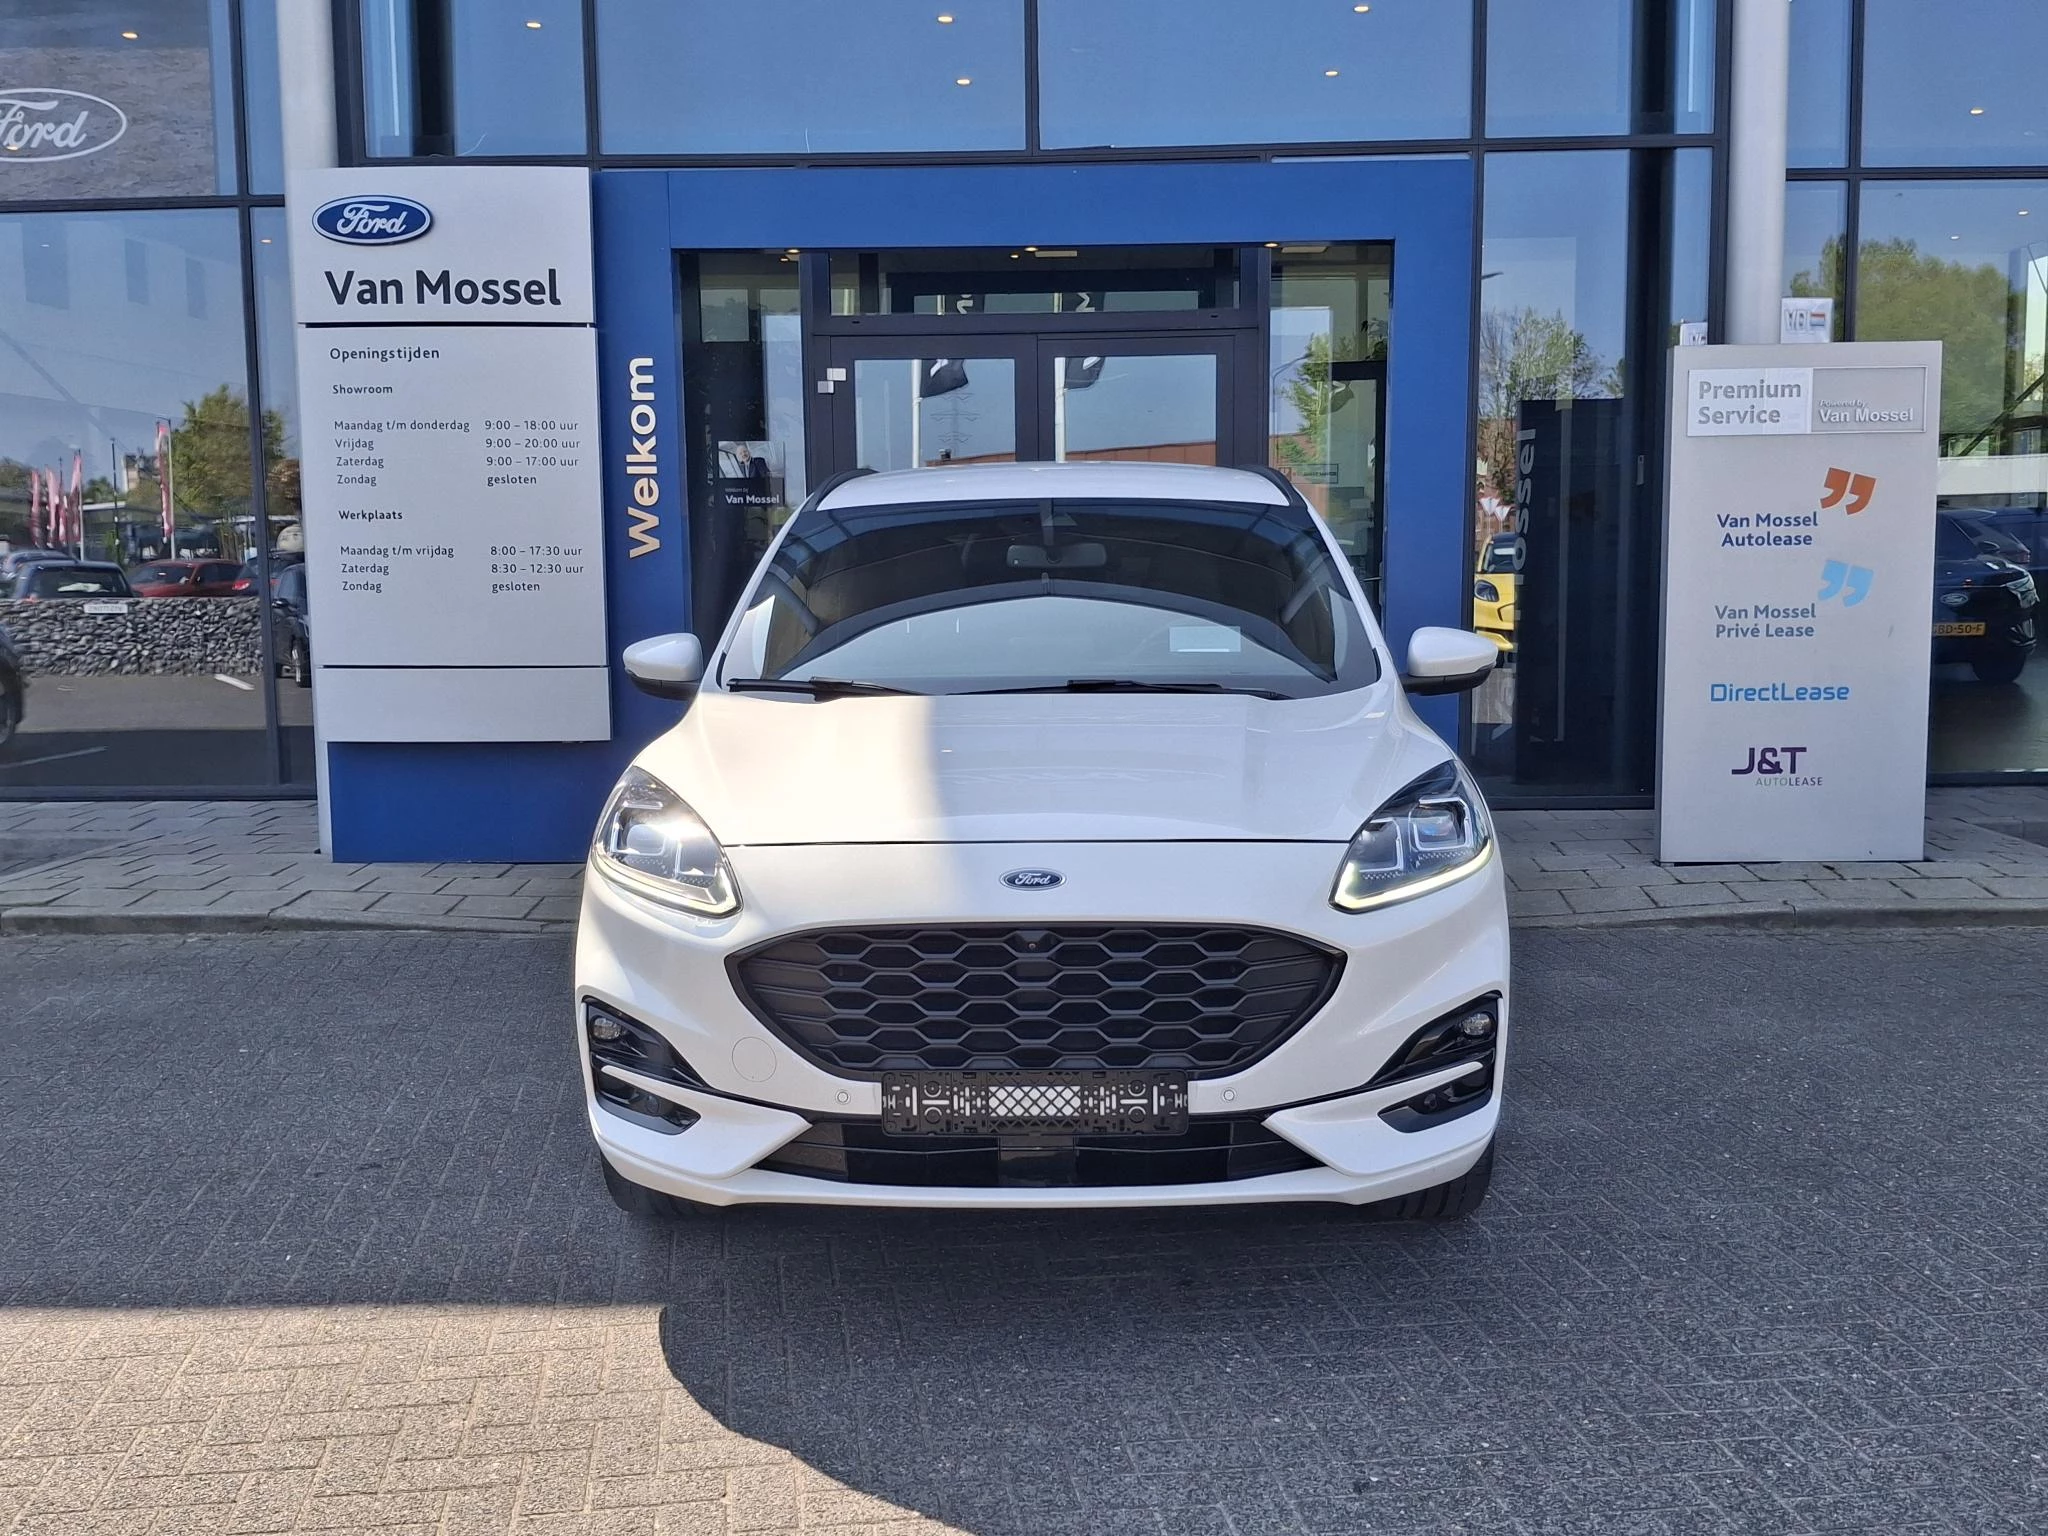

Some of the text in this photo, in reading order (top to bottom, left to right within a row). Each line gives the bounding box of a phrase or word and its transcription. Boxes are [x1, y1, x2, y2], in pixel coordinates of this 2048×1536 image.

[0, 99, 89, 149] Ford
[336, 202, 407, 235] Ford
[324, 268, 562, 306] Van Mossel
[329, 347, 440, 363] Openingstijden
[332, 384, 393, 395] Showroom
[1698, 379, 1802, 400] Premium
[1697, 405, 1781, 425] Service
[1819, 407, 1914, 422] Van Mossel
[334, 419, 470, 432] Maandag t/m donderdag
[484, 420, 511, 431] 9:00
[523, 420, 556, 431] 18:00
[559, 422, 579, 431] uur
[335, 438, 374, 451] Vrijdag
[485, 438, 512, 449] 9:00
[524, 438, 558, 449] 20:00
[561, 440, 581, 449] uur
[336, 456, 385, 469] Zaterdag
[486, 456, 513, 467] 9:00
[525, 456, 556, 467] 17:00
[560, 458, 579, 467] uur
[625, 357, 661, 559] Welkom
[336, 474, 377, 487] Zondag
[487, 474, 537, 486] gesloten
[725, 493, 780, 504] Van Mossel
[338, 509, 403, 523] Werkplaats
[1717, 511, 1818, 528] Van Mossel
[1721, 531, 1813, 547] Autolease
[340, 545, 455, 558] Maandag t/m vrijdag
[490, 545, 517, 556] 8:00
[529, 545, 560, 556] 17:30
[563, 547, 583, 556] uur
[341, 563, 390, 576] Zaterdag
[491, 563, 517, 574] 8:30
[530, 563, 562, 574] 12:30
[565, 565, 584, 574] uur
[342, 581, 382, 593] Zondag
[491, 581, 541, 593] gesloten
[1715, 603, 1817, 619] Van Mossel
[1716, 623, 1815, 638] Privé Lease
[1933, 624, 1984, 635] BD-50-F
[1710, 682, 1850, 702] DirectLease
[1731, 747, 1807, 775] J&T
[1755, 776, 1823, 787] AUTOLEASE
[1014, 872, 1052, 885] Ford
